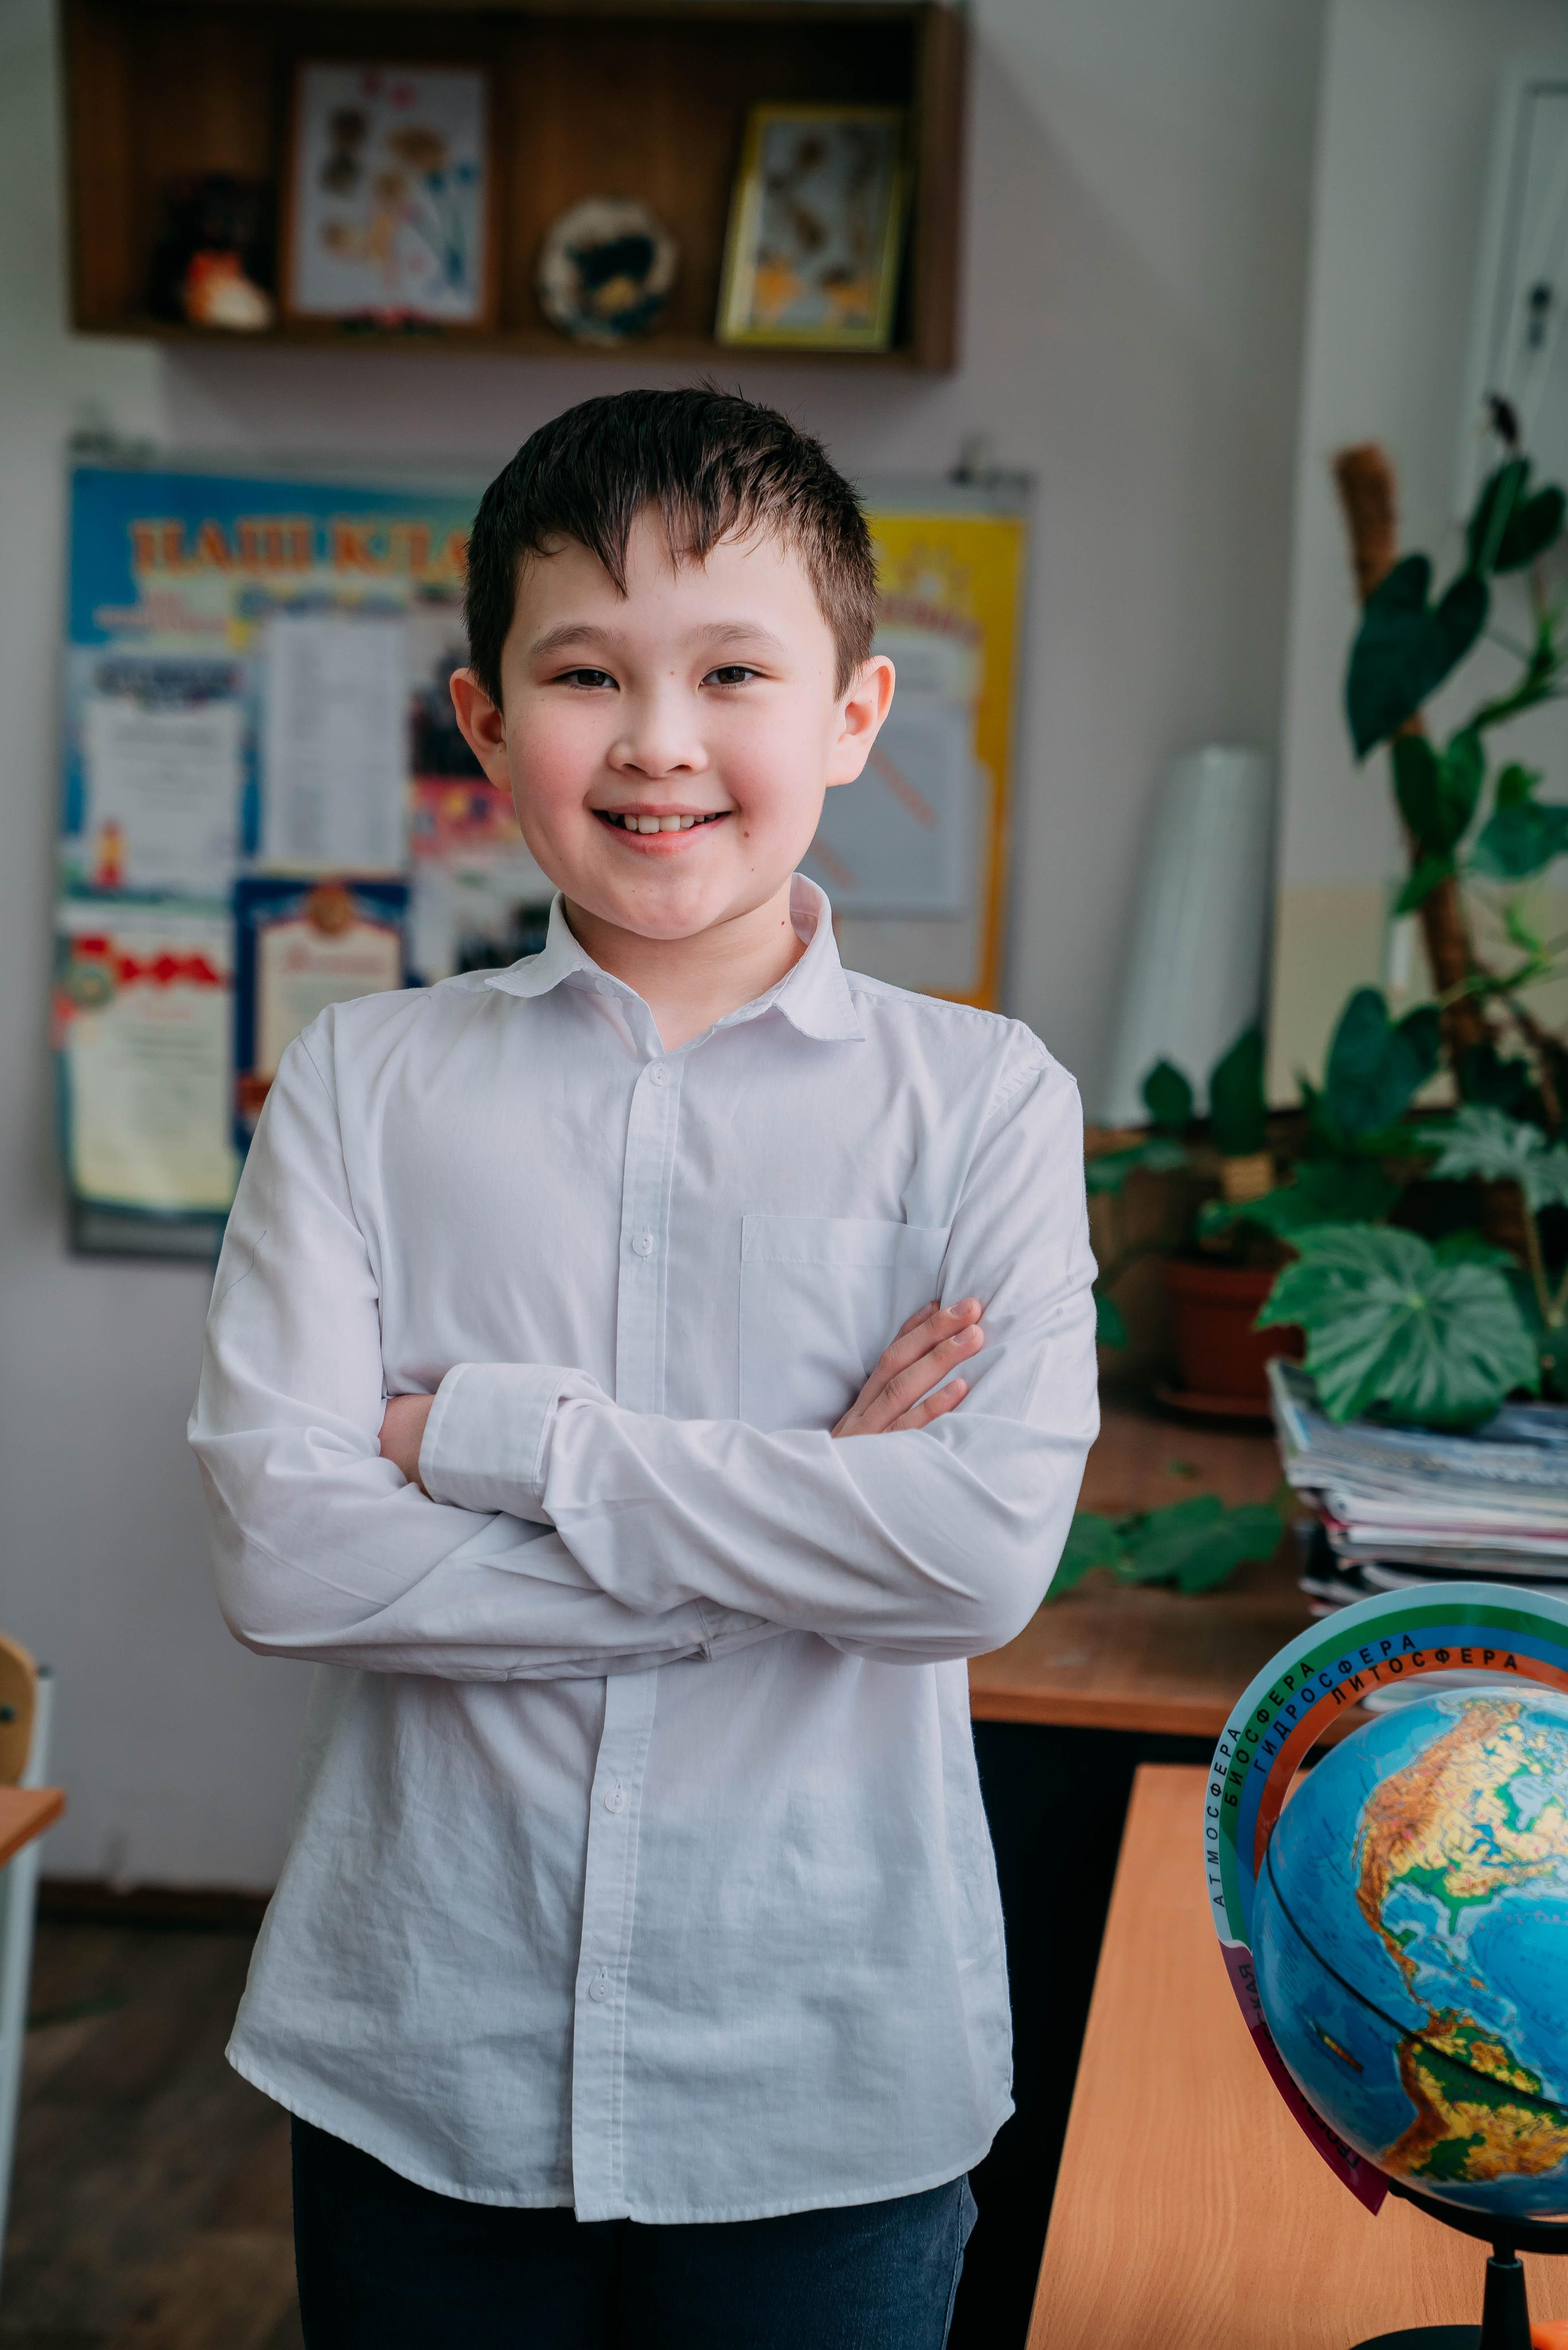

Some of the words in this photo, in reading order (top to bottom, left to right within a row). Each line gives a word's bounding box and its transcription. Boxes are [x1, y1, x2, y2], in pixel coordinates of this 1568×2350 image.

[333, 519, 469, 577] КЛА
[1224, 1662, 1315, 1807] БИОСФЕРА
[1253, 1634, 1416, 1773] ГИДРОСФЕРА
[1332, 1648, 1518, 1705] ЛИТОСФЕРА
[1205, 1728, 1242, 1907] АТМОСФЕРА
